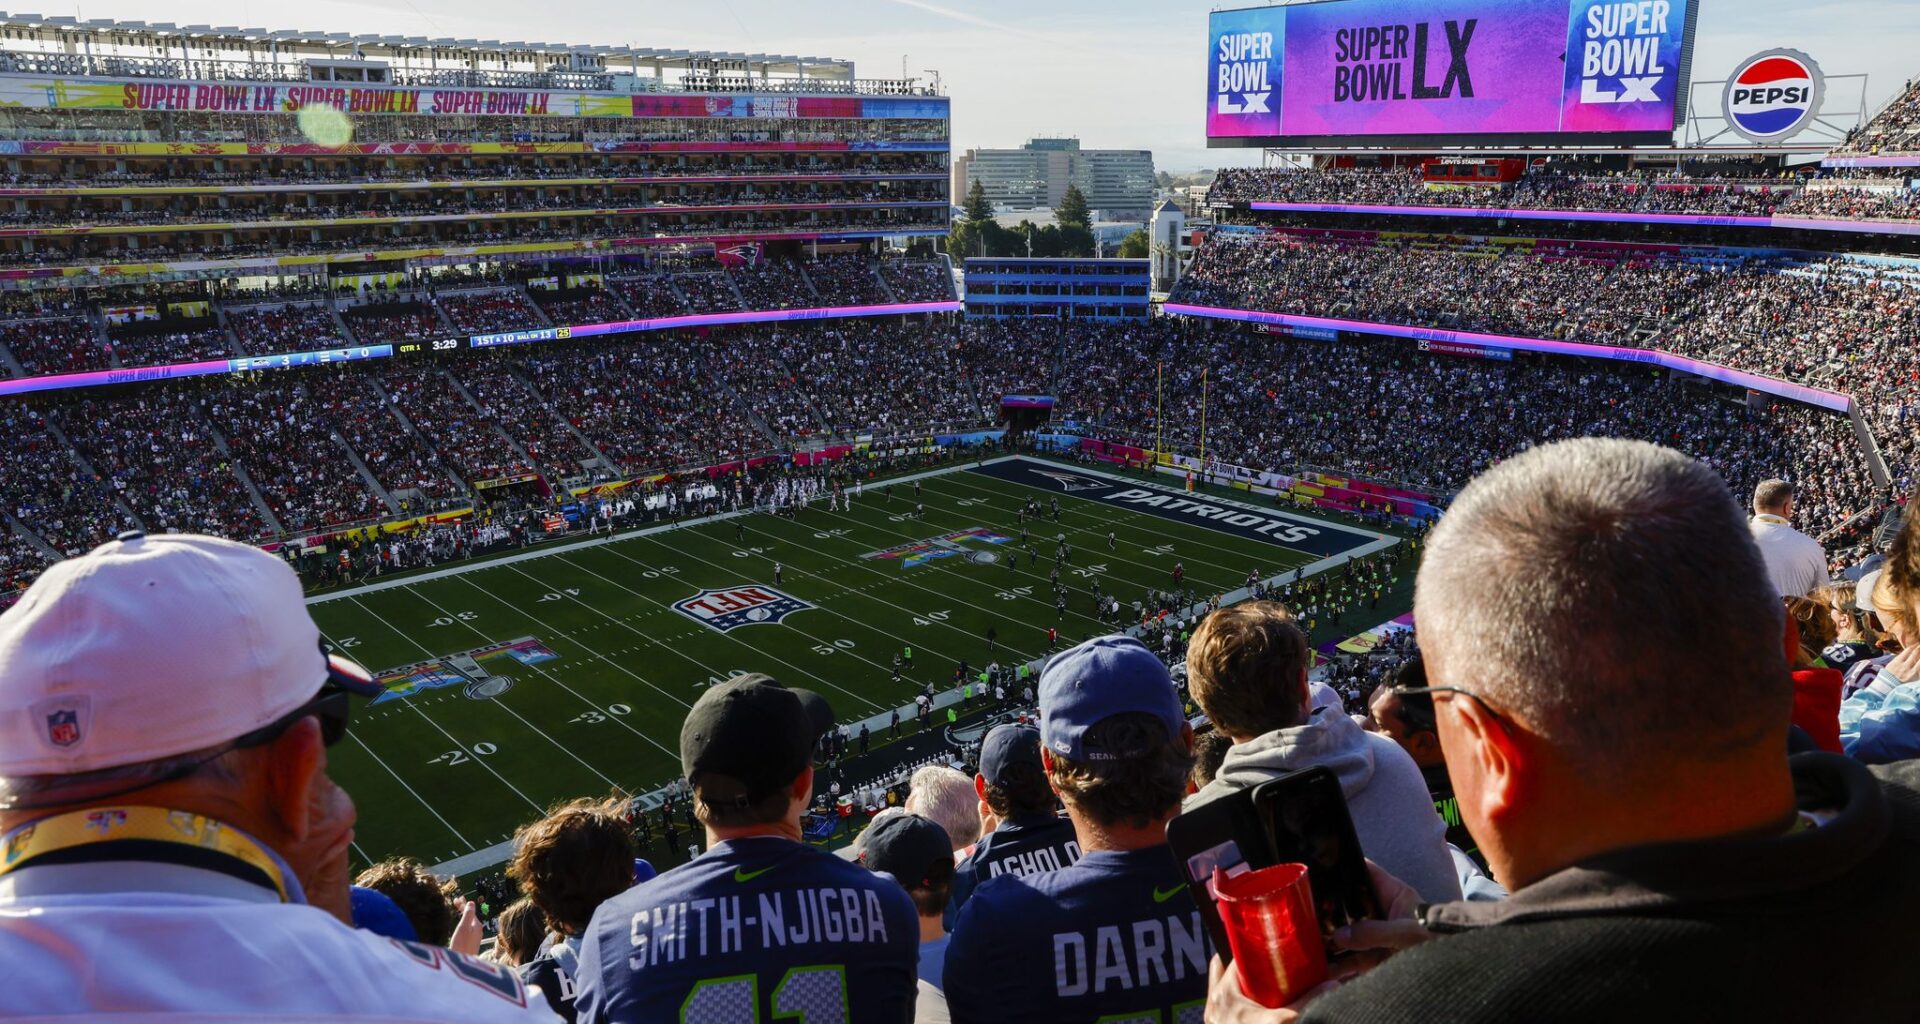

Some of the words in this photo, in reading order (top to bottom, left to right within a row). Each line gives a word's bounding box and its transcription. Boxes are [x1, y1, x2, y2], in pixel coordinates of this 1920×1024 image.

[1587, 1, 1670, 38] SUPER
[1219, 32, 1272, 62] SUPER
[1335, 25, 1409, 62] SUPER
[1334, 63, 1406, 101] BOWL
[1411, 19, 1478, 99] LX
[1582, 37, 1664, 77] BOWL
[1218, 62, 1271, 92] BOWL
[123, 83, 190, 109] SUPER
[195, 85, 248, 110] BOWL
[253, 87, 276, 110] LX
[287, 88, 346, 111] SUPER
[349, 89, 395, 112] BOWL
[400, 91, 420, 112] LX
[1580, 77, 1663, 104] LX
[1733, 87, 1809, 105] PEPSI
[432, 91, 483, 114] SUPER
[486, 93, 527, 114] BOWL
[531, 94, 549, 114] LX
[1218, 92, 1271, 114] LX
[432, 340, 458, 351] 3:29
[477, 337, 494, 345] 1ST
[557, 329, 569, 337] 25
[361, 348, 369, 357] 0
[400, 345, 416, 353] QTR
[1456, 347, 1511, 358] PATRIOTS
[281, 356, 290, 365] 3
[107, 370, 136, 382] SUPER
[137, 368, 160, 380] BOWL
[162, 367, 172, 377] LX
[1237, 468, 1261, 480] LX
[1102, 489, 1320, 543] PATRIOTS
[642, 566, 681, 579] 50
[544, 588, 580, 601] 40
[685, 589, 778, 615] NFL
[995, 587, 1032, 601] 30
[434, 611, 479, 627] 30
[912, 611, 949, 626] 40
[811, 639, 856, 655] 50
[378, 662, 428, 677] BOW
[580, 703, 632, 724] 30
[441, 742, 498, 766] 20
[629, 888, 888, 971] SMITH-NJIGBA
[1053, 911, 1217, 997] DARN
